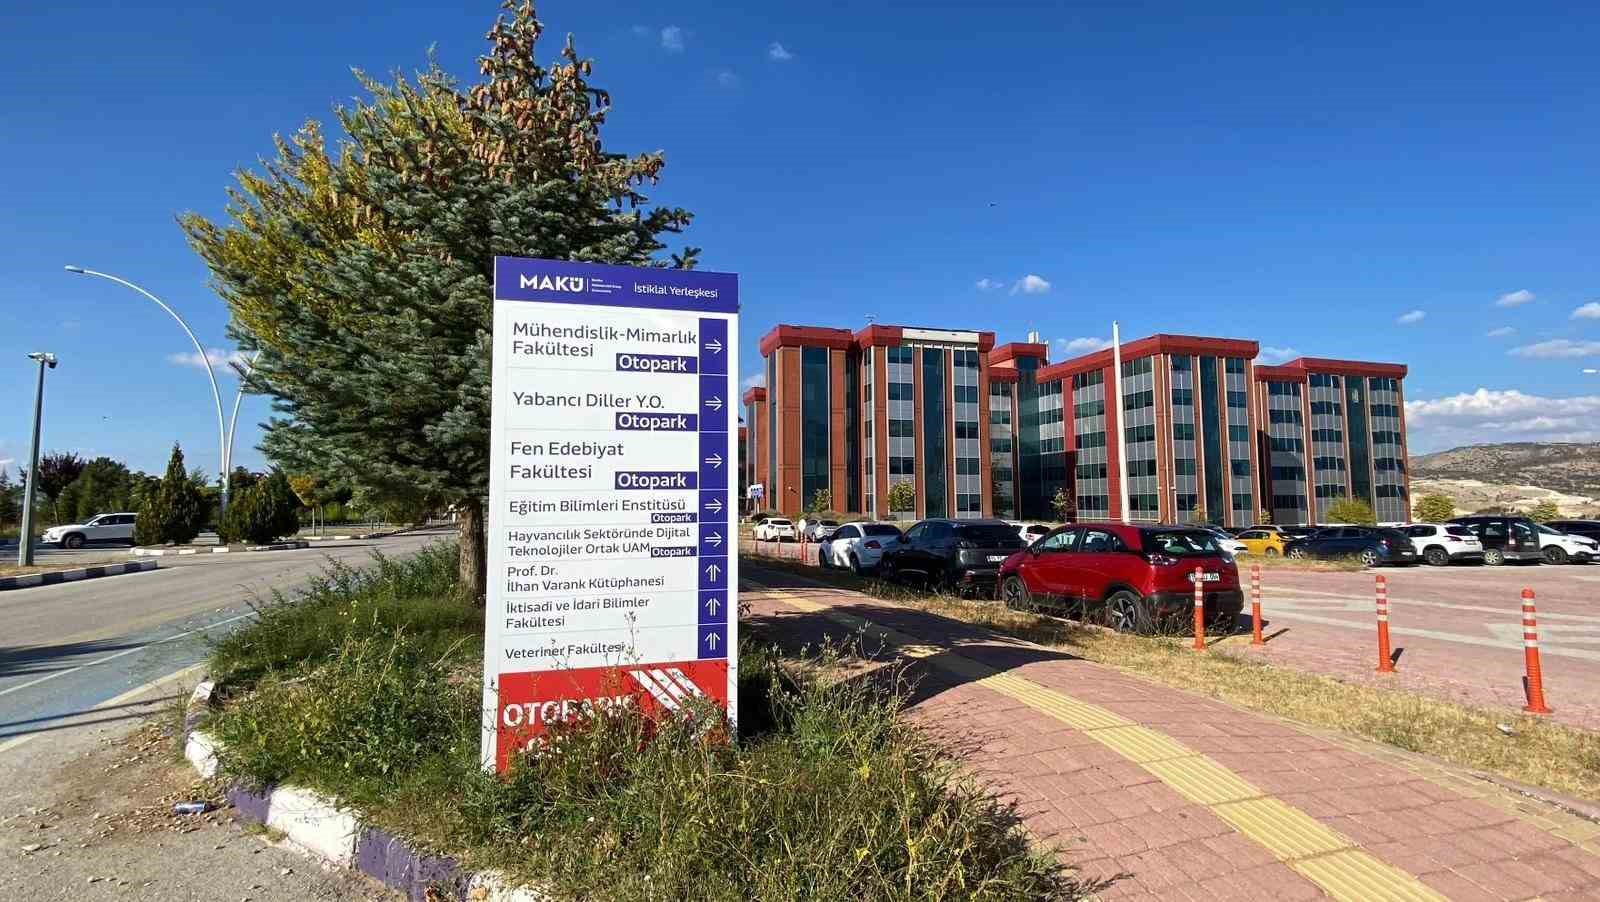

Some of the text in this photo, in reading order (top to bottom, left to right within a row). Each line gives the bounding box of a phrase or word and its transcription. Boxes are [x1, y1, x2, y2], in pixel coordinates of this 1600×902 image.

[520, 273, 584, 293] MAKÜ
[670, 286, 718, 299] Yerleşkesi
[513, 322, 697, 344] Mühendislik-Mimarlık
[513, 341, 594, 357] Fakültesi
[619, 355, 687, 373] Otopark
[513, 391, 665, 409] Yabancı Diller Y.O.
[619, 414, 687, 431] Otopark
[511, 441, 624, 459] Fen Edebiyat
[511, 464, 592, 479] Fakültesi
[618, 473, 687, 490] Otopark
[510, 499, 686, 516] Eğitim Bilimleri Enstitüsü
[652, 513, 691, 524] Otopark
[508, 526, 690, 544] Hayvancılık Sektöründe Dijital
[509, 542, 650, 558] Teknolojiler Ortak UAM
[652, 547, 691, 557] Otopark
[508, 565, 558, 577] Prof. Dr.
[507, 576, 665, 592] İlhan Varank Kütüphanesi
[506, 597, 650, 614] İktisadi ve İdari Bilimler
[506, 616, 565, 629] Fakültesi
[505, 642, 625, 659] Veteriner Fakültesi
